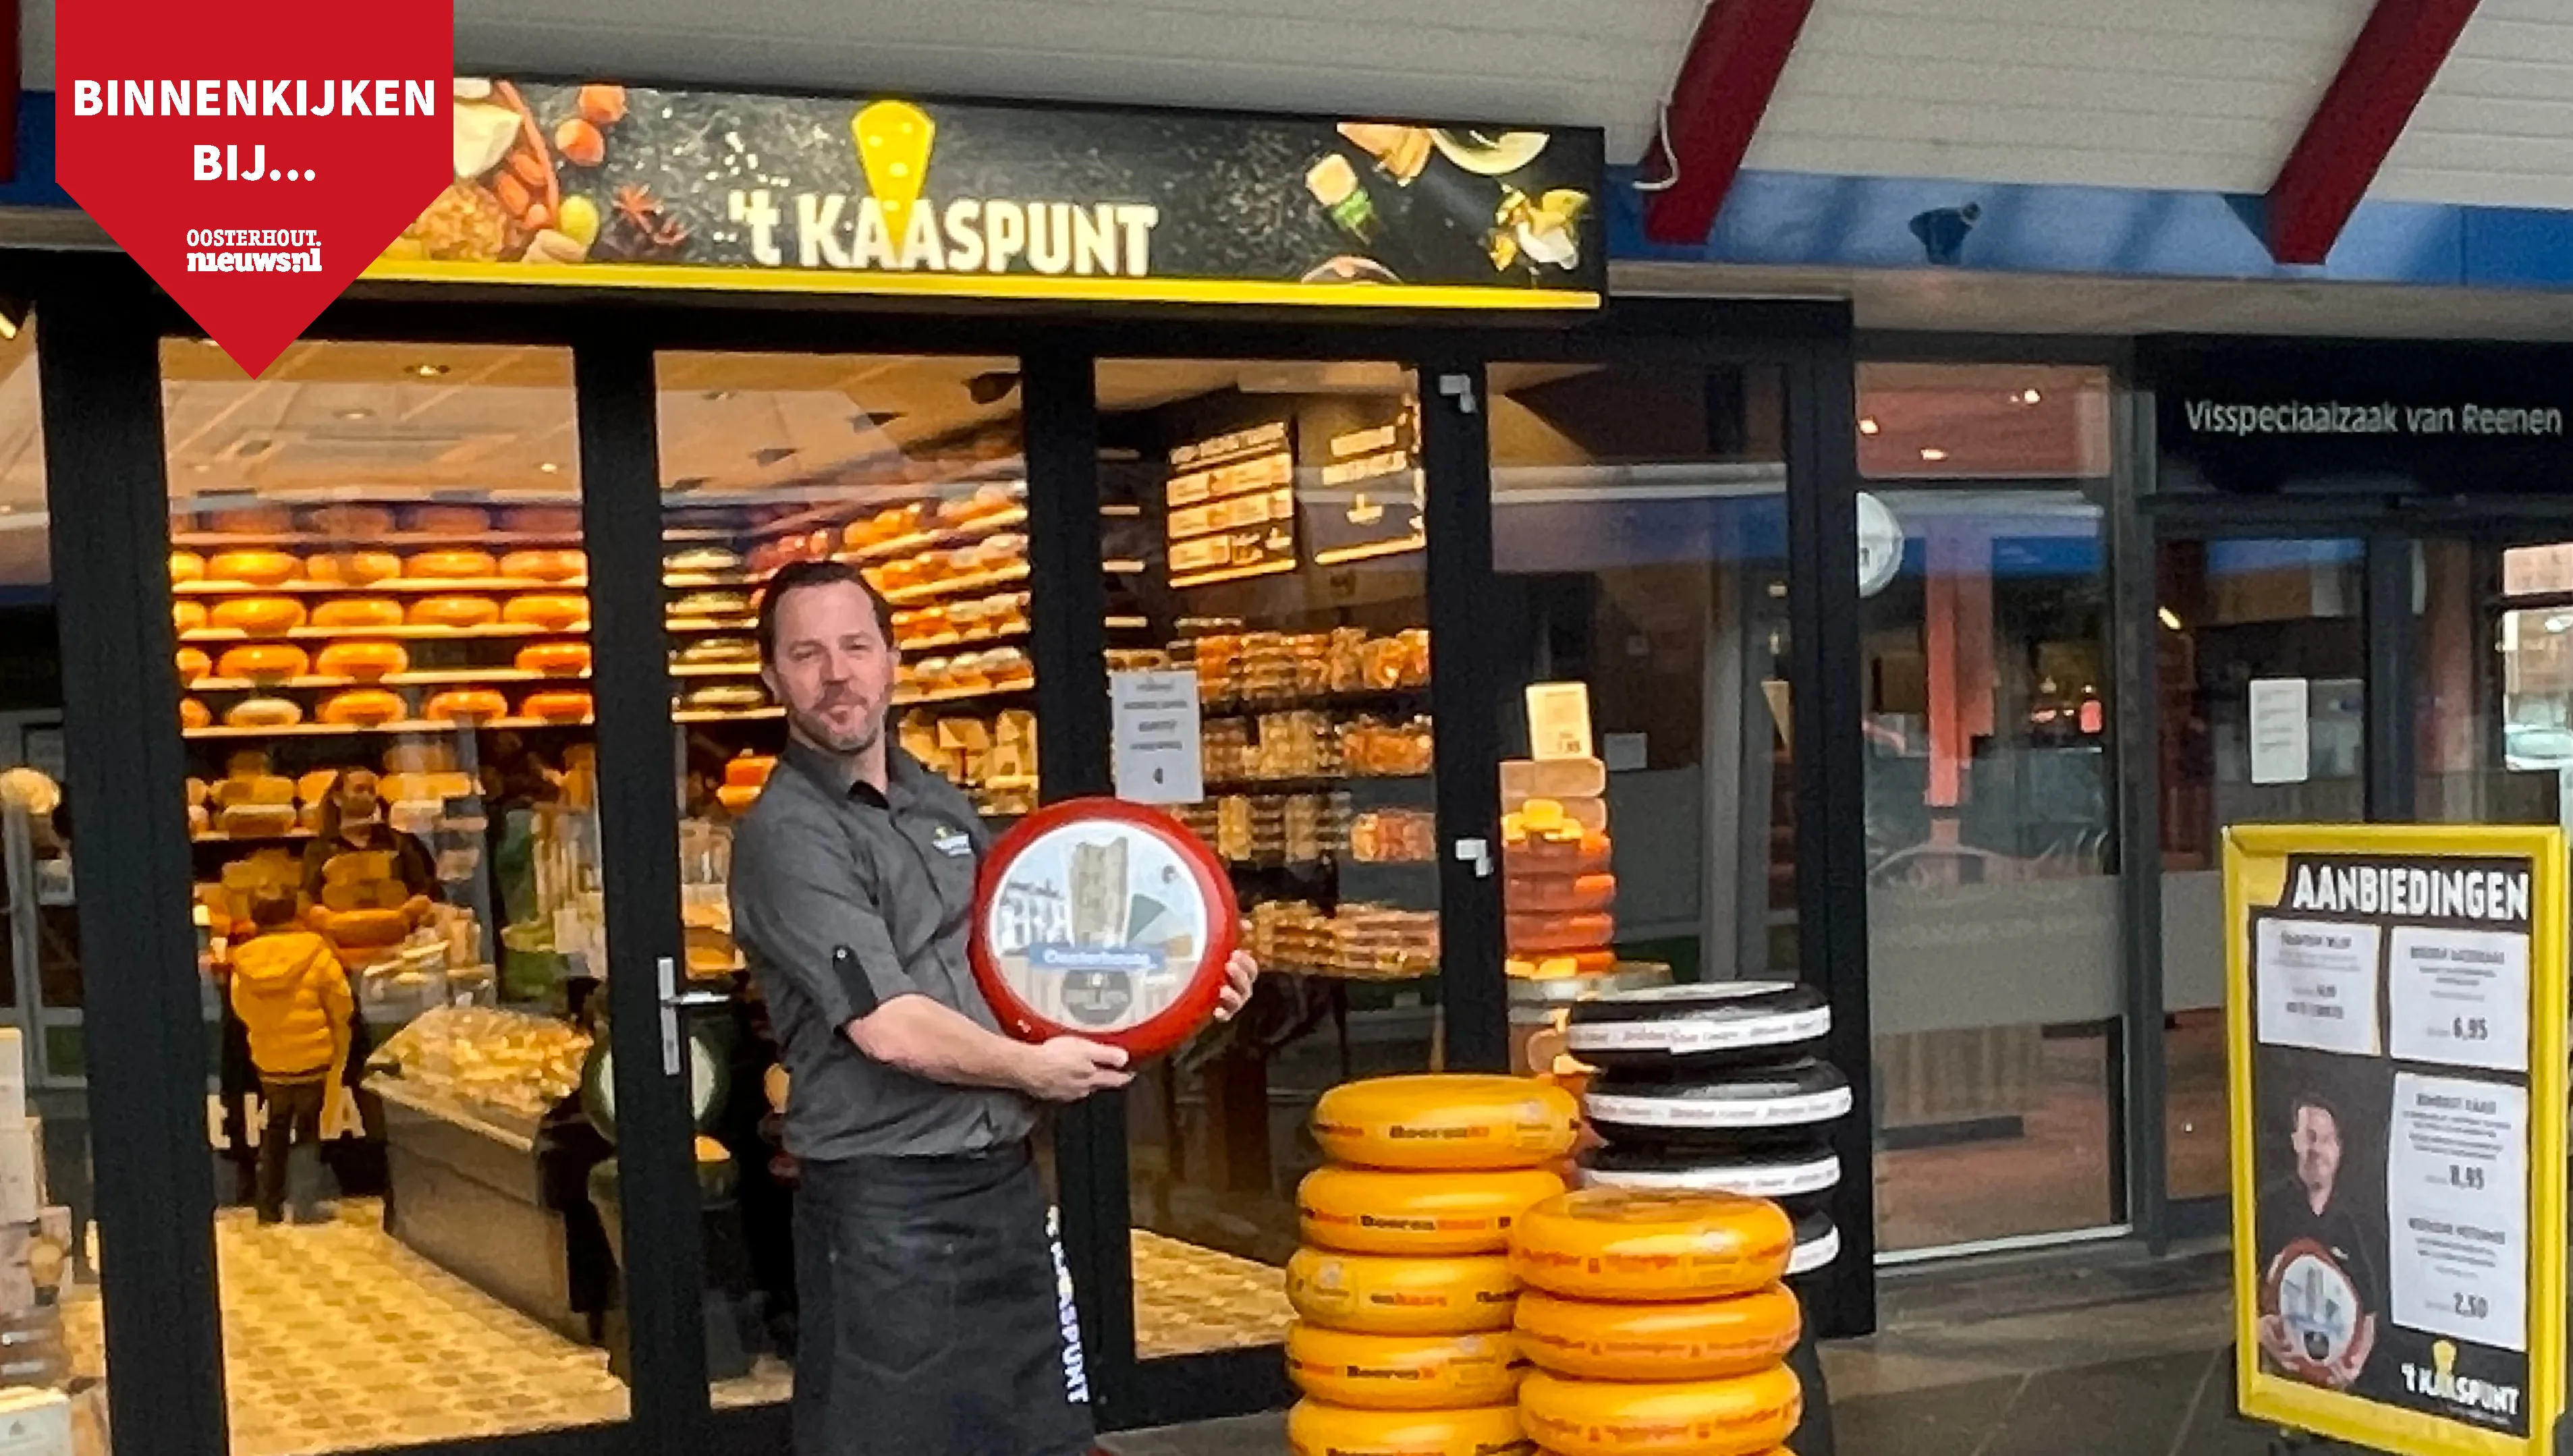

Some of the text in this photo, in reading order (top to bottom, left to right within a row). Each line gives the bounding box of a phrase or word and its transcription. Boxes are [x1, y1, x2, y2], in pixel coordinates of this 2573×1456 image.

[727, 190, 1159, 277] 't KAASPUNT
[2186, 399, 2564, 437] Visspeciaalzaak van Reenen
[2292, 864, 2528, 920] AANBIEDINGEN
